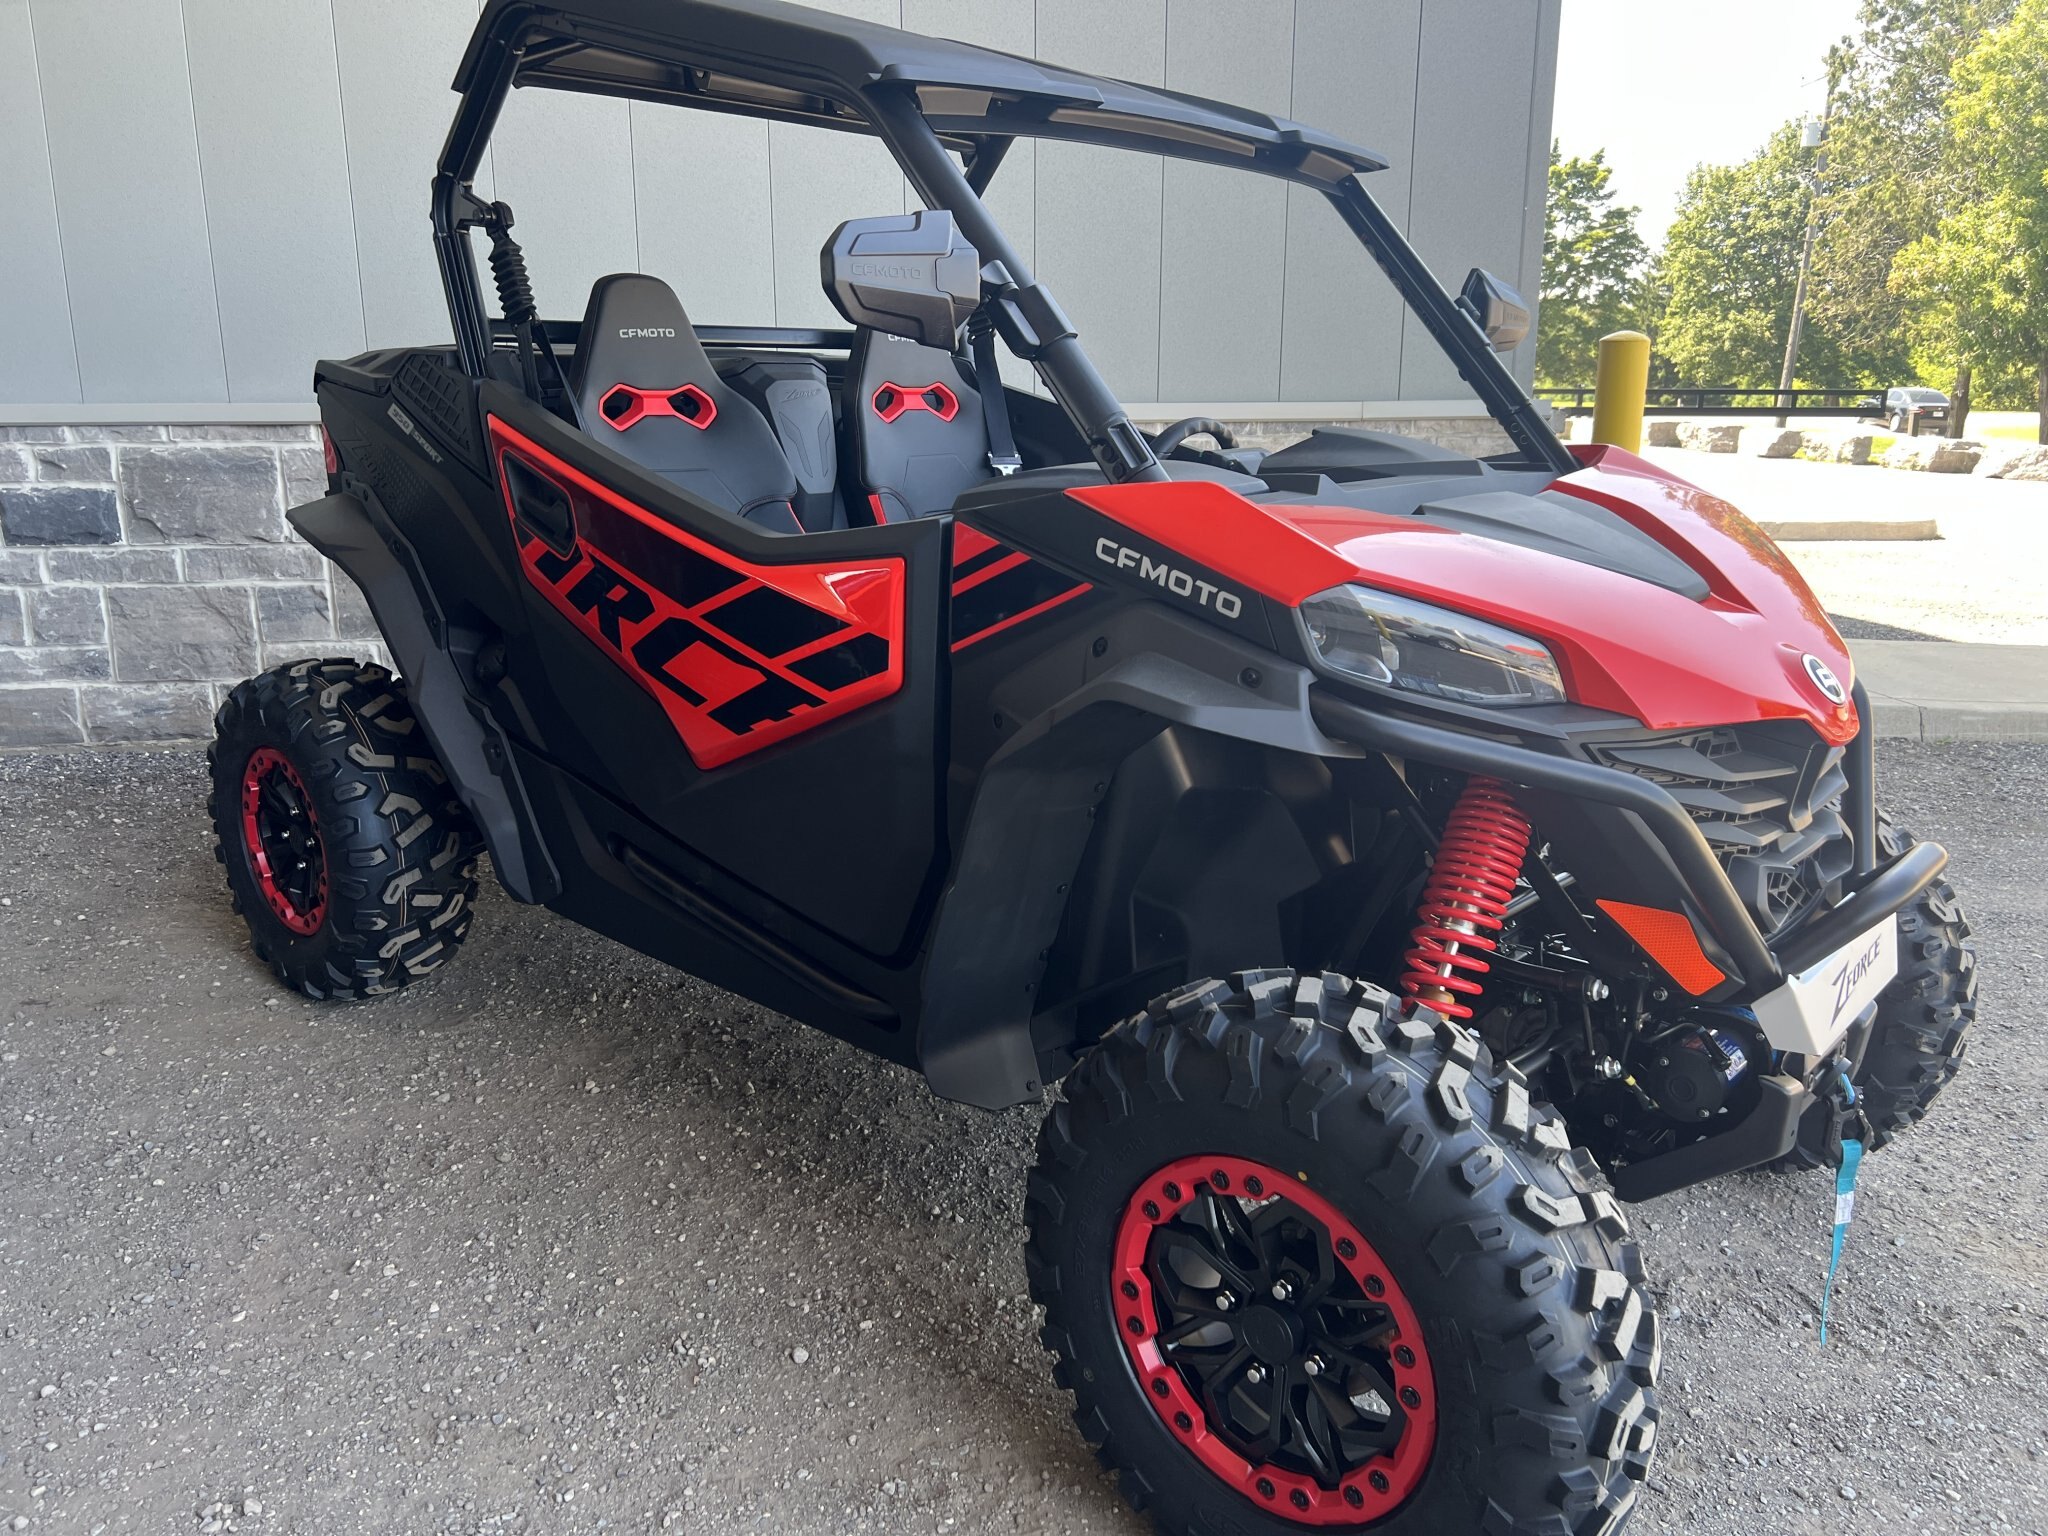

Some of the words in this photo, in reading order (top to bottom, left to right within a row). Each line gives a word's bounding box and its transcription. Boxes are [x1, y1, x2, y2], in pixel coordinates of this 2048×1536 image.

[851, 263, 921, 279] CFMOTO
[619, 328, 676, 338] CFMOTO
[389, 406, 413, 432] 950
[411, 431, 444, 463] SPORT
[1095, 537, 1242, 619] CFMOTO
